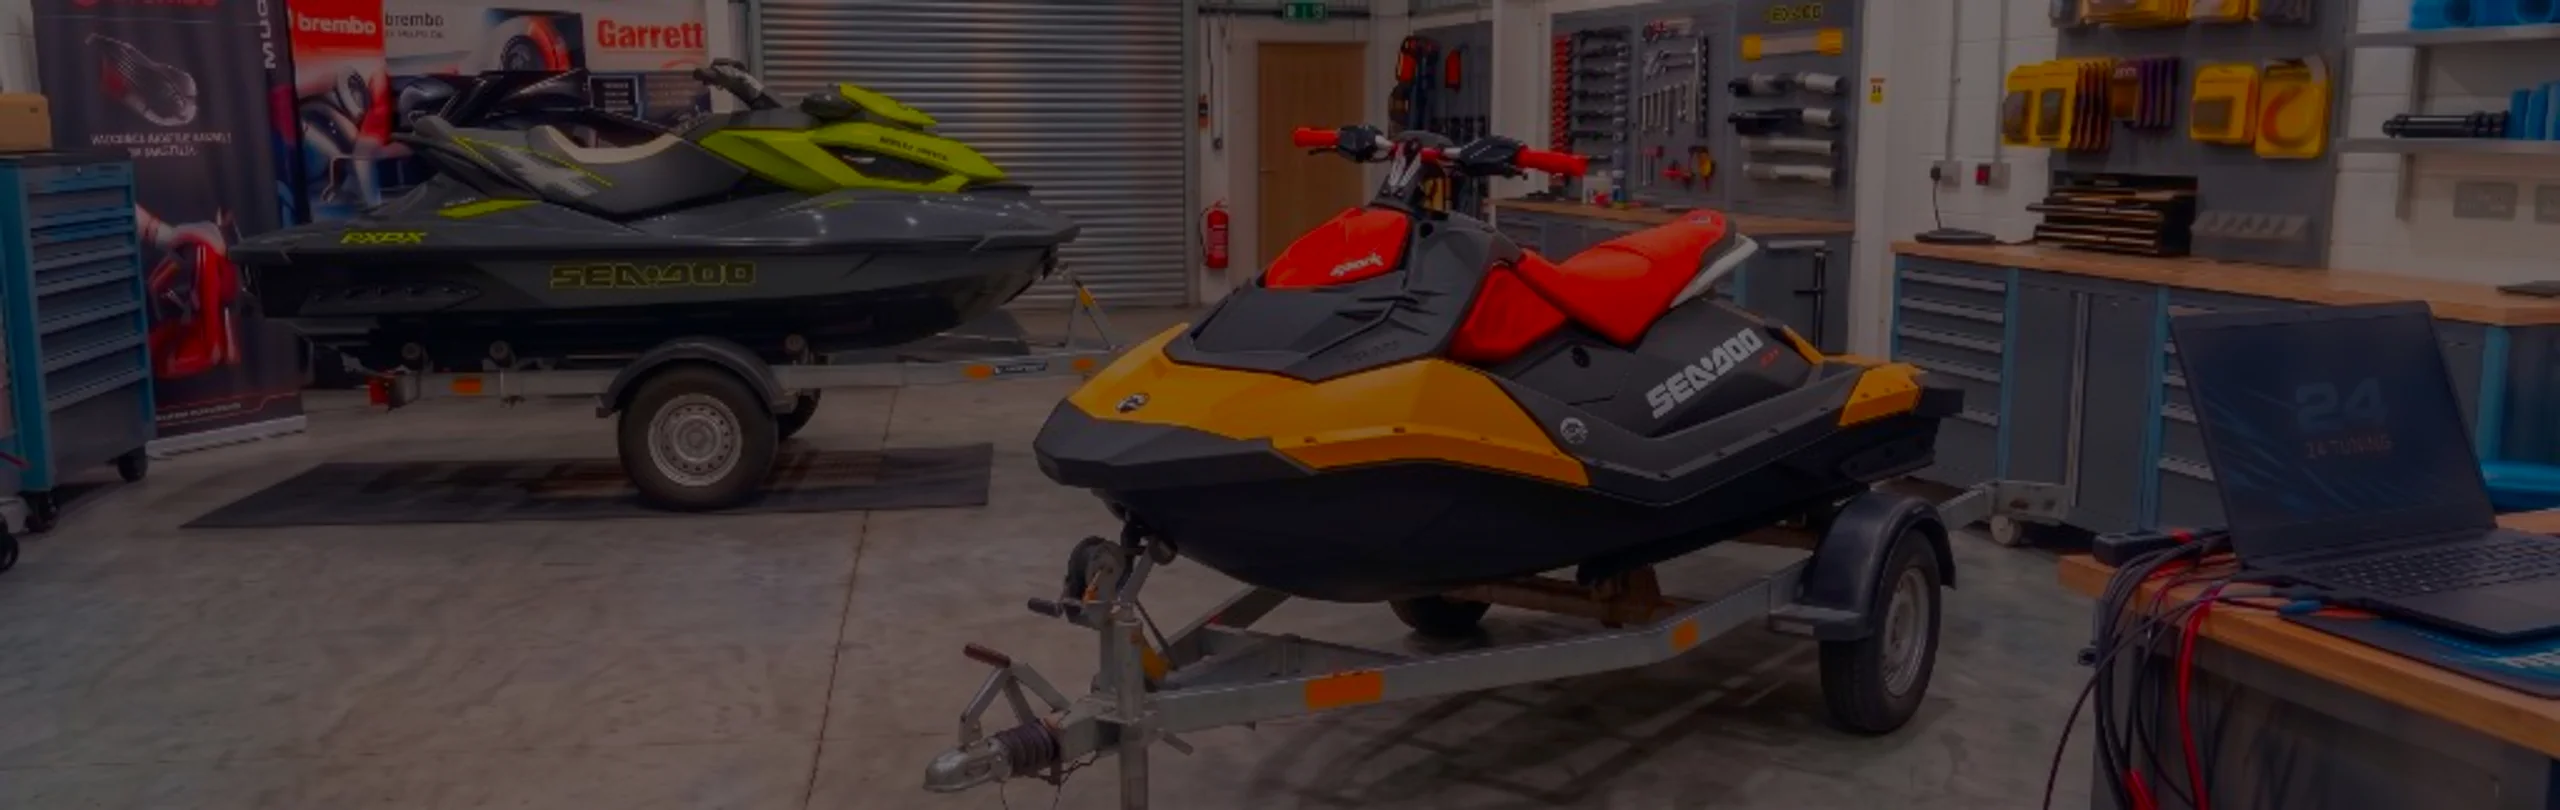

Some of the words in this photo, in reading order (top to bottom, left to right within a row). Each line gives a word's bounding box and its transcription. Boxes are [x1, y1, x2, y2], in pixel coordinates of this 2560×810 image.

[299, 11, 376, 35] brembo
[385, 12, 444, 27] brembo
[597, 19, 704, 48] Garrett
[2295, 378, 2389, 433] 24
